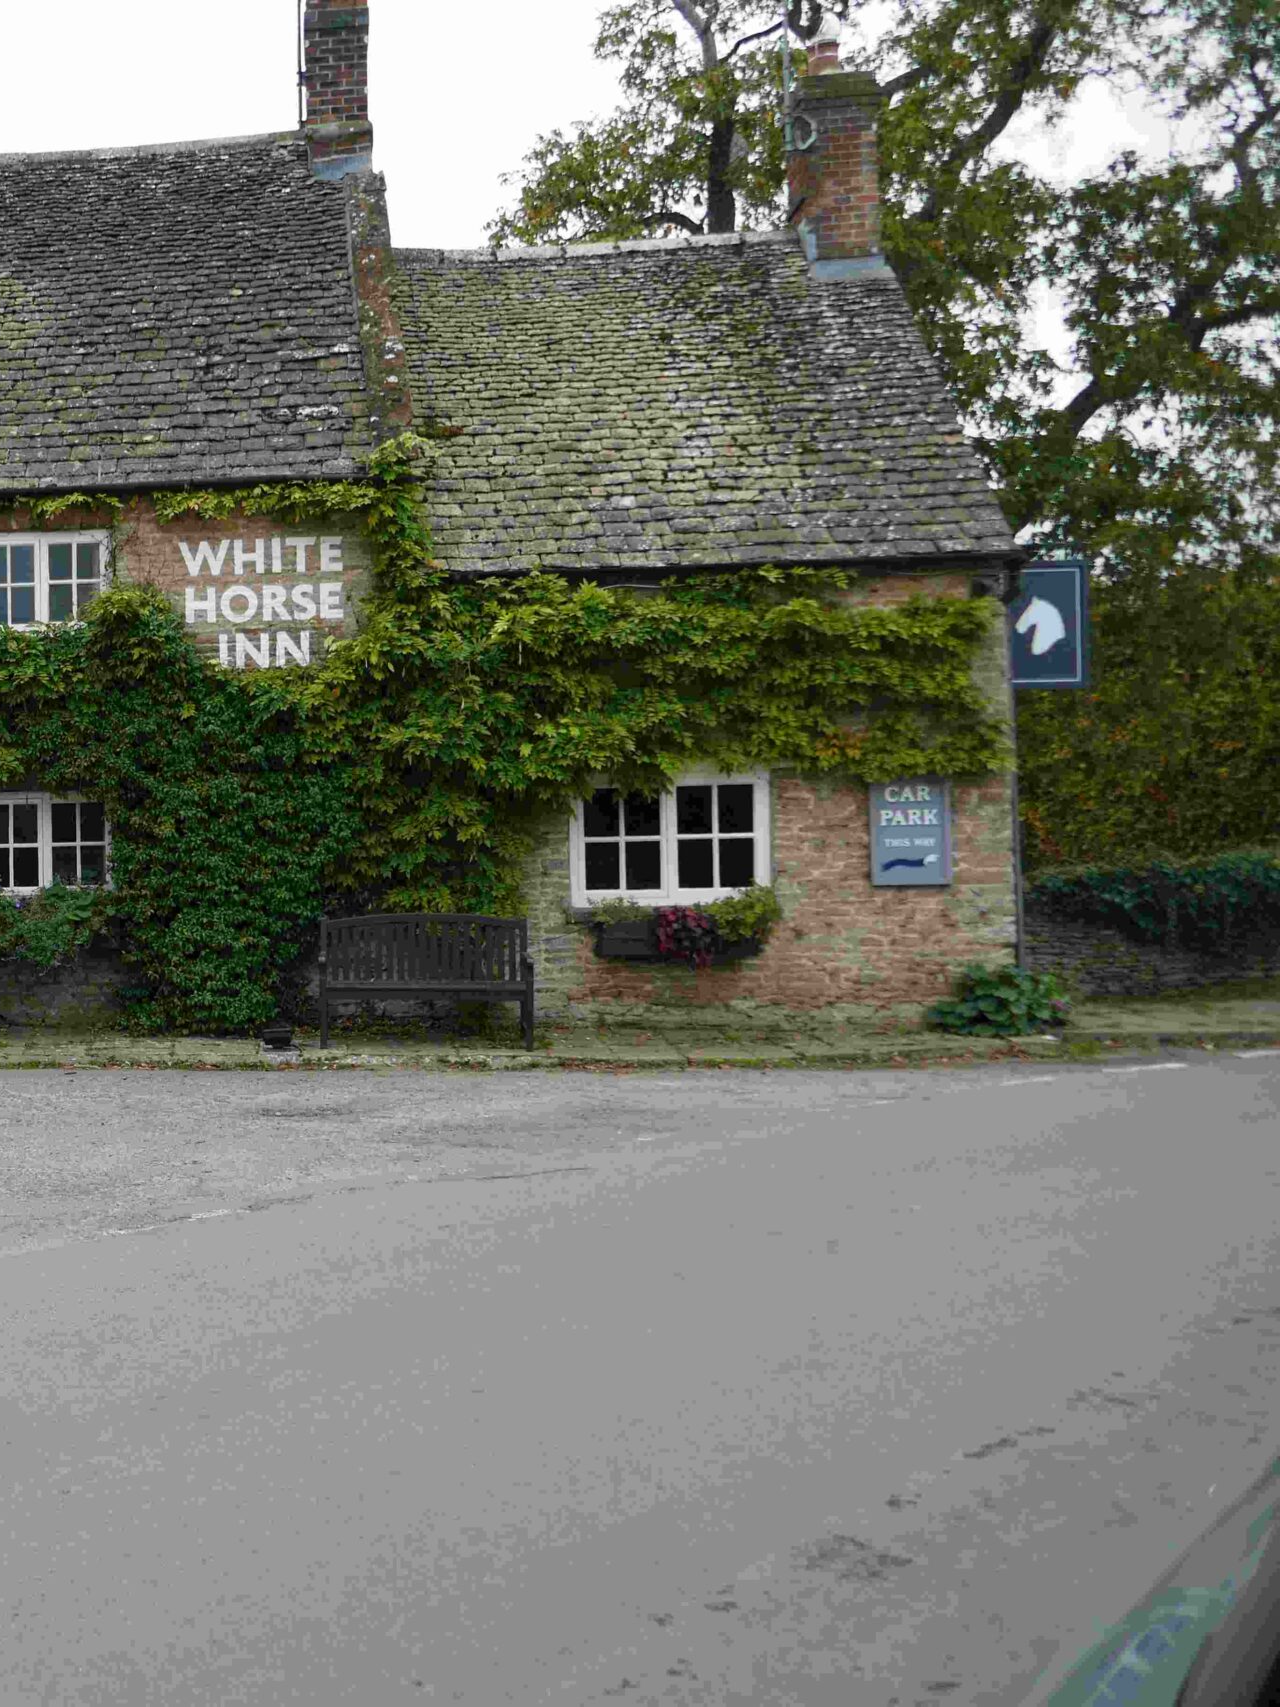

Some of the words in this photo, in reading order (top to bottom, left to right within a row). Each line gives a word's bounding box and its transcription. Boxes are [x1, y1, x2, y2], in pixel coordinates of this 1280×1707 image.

[178, 536, 344, 577] WHITE
[185, 582, 345, 624] HORSE
[218, 631, 311, 669] INN
[884, 785, 931, 802] CAR
[880, 808, 939, 826] PARK
[884, 838, 911, 848] THIS
